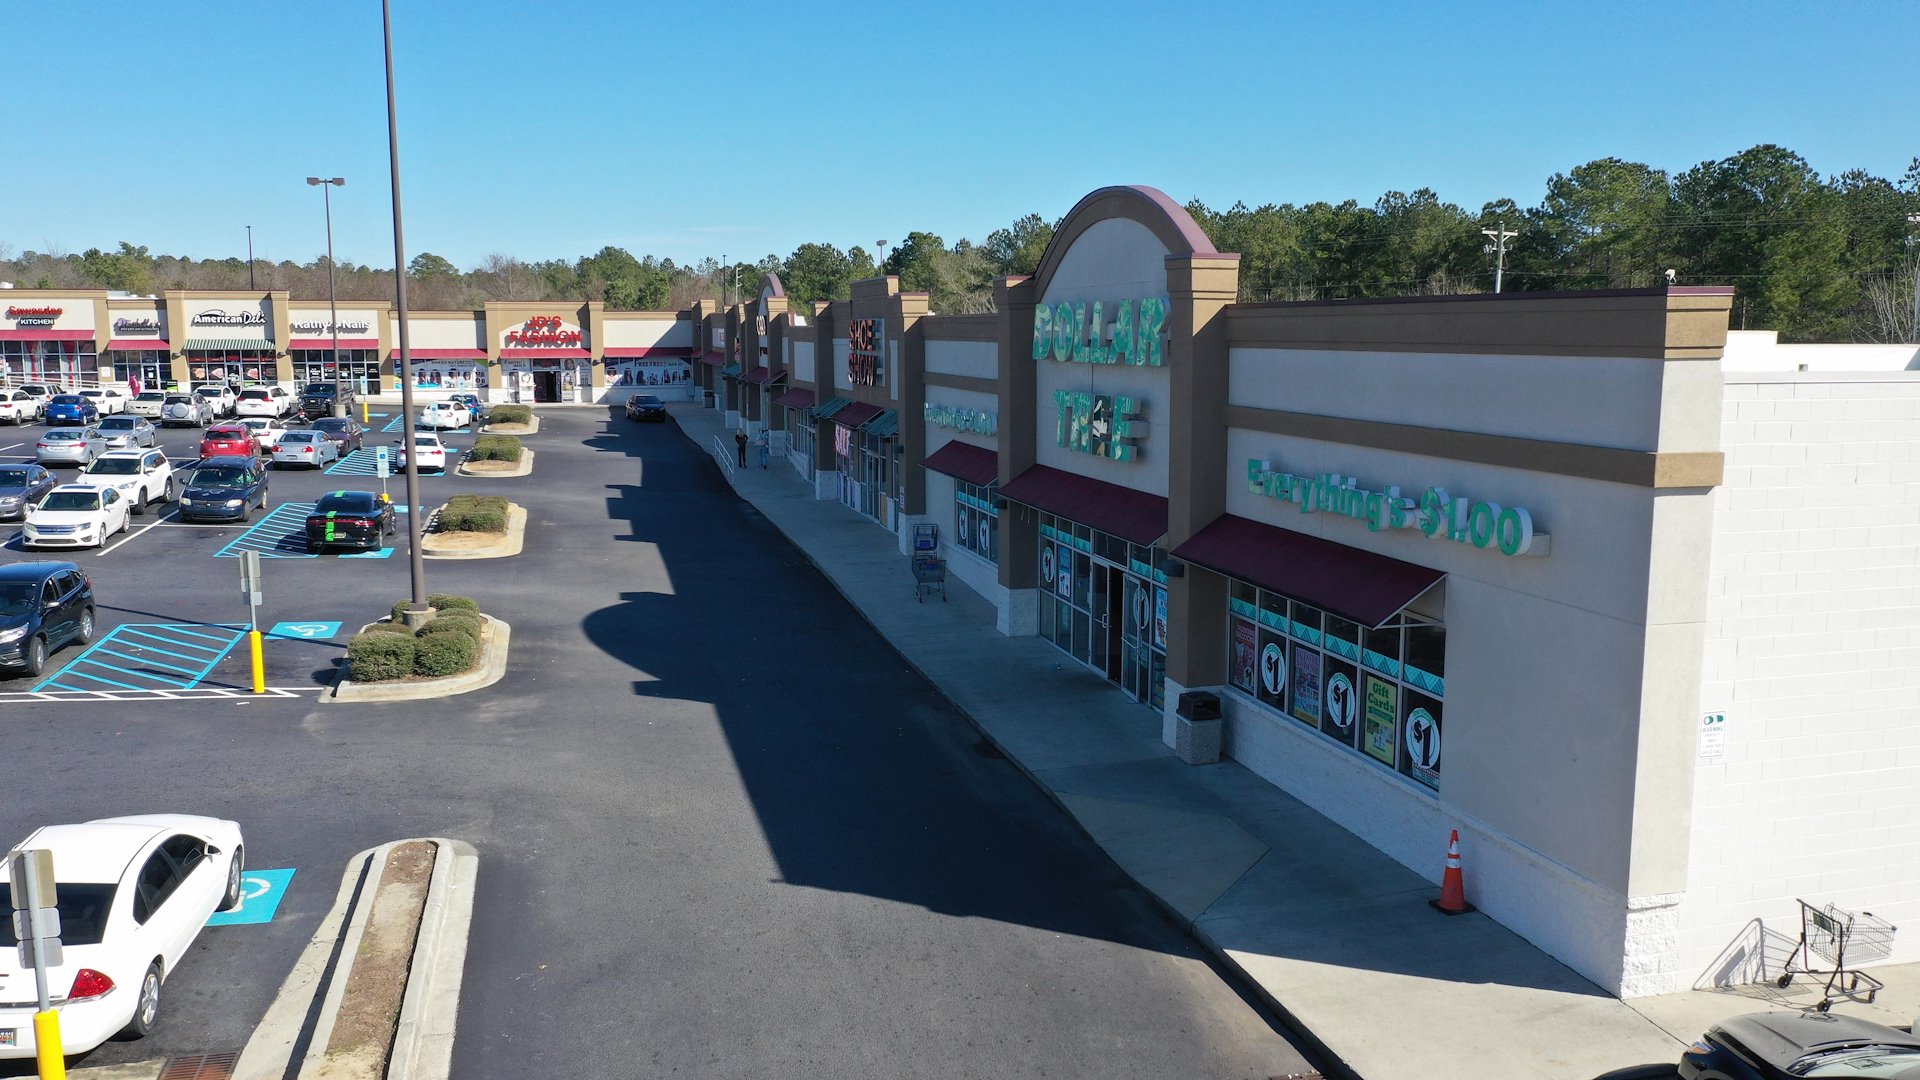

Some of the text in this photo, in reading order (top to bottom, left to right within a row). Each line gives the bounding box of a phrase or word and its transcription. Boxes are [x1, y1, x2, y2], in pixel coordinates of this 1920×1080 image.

[194, 311, 267, 325] American Deli
[342, 319, 371, 330] Nails
[528, 315, 562, 329] JD'S
[1032, 298, 1170, 366] DOLLAR
[508, 331, 582, 344] FASHION
[849, 319, 873, 351] SHOE
[848, 353, 875, 387] SHOW
[1054, 389, 1144, 463] TREE
[1247, 458, 1530, 557] Everything's $1.00
[1267, 653, 1280, 692] $1
[1333, 683, 1349, 726] $1
[1367, 693, 1395, 714] Cards
[1372, 682, 1390, 699] Gift
[1413, 719, 1432, 767] $1
